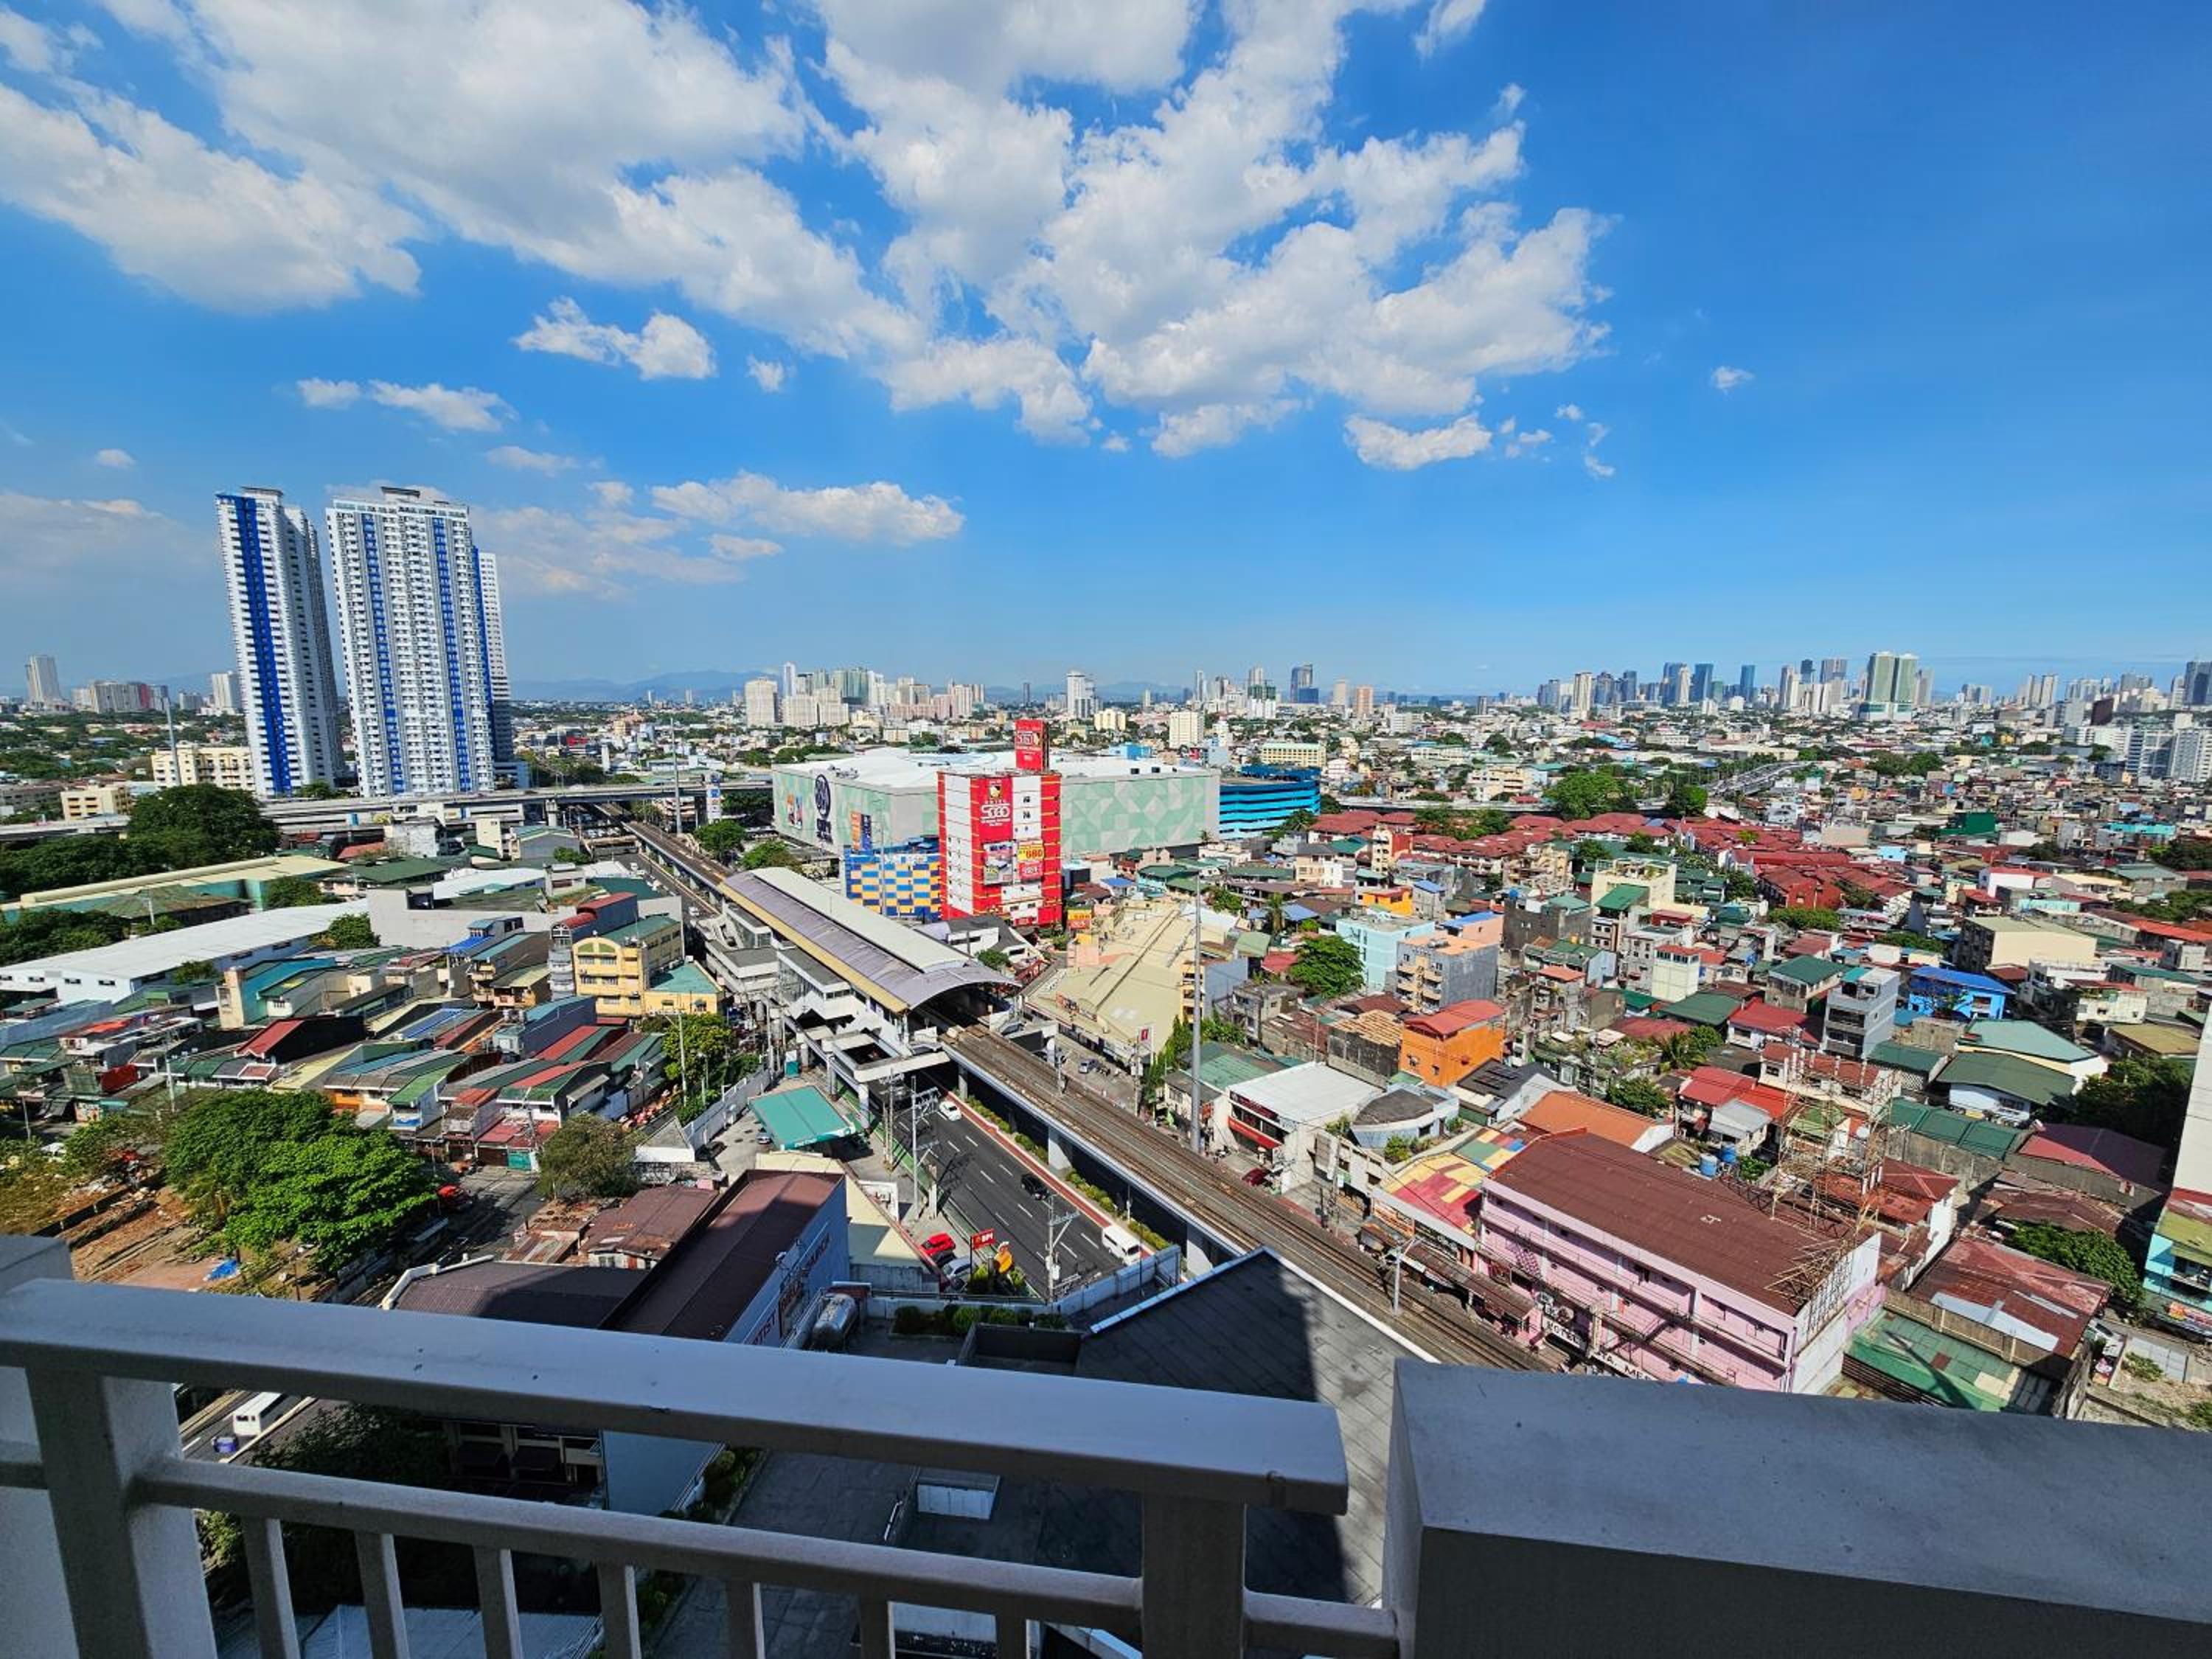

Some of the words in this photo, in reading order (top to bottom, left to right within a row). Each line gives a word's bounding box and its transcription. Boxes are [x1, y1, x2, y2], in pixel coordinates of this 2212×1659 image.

[981, 803, 1010, 818] SOGO
[982, 1233, 993, 1242] BPI
[1546, 1320, 1582, 1344] HOTEL
